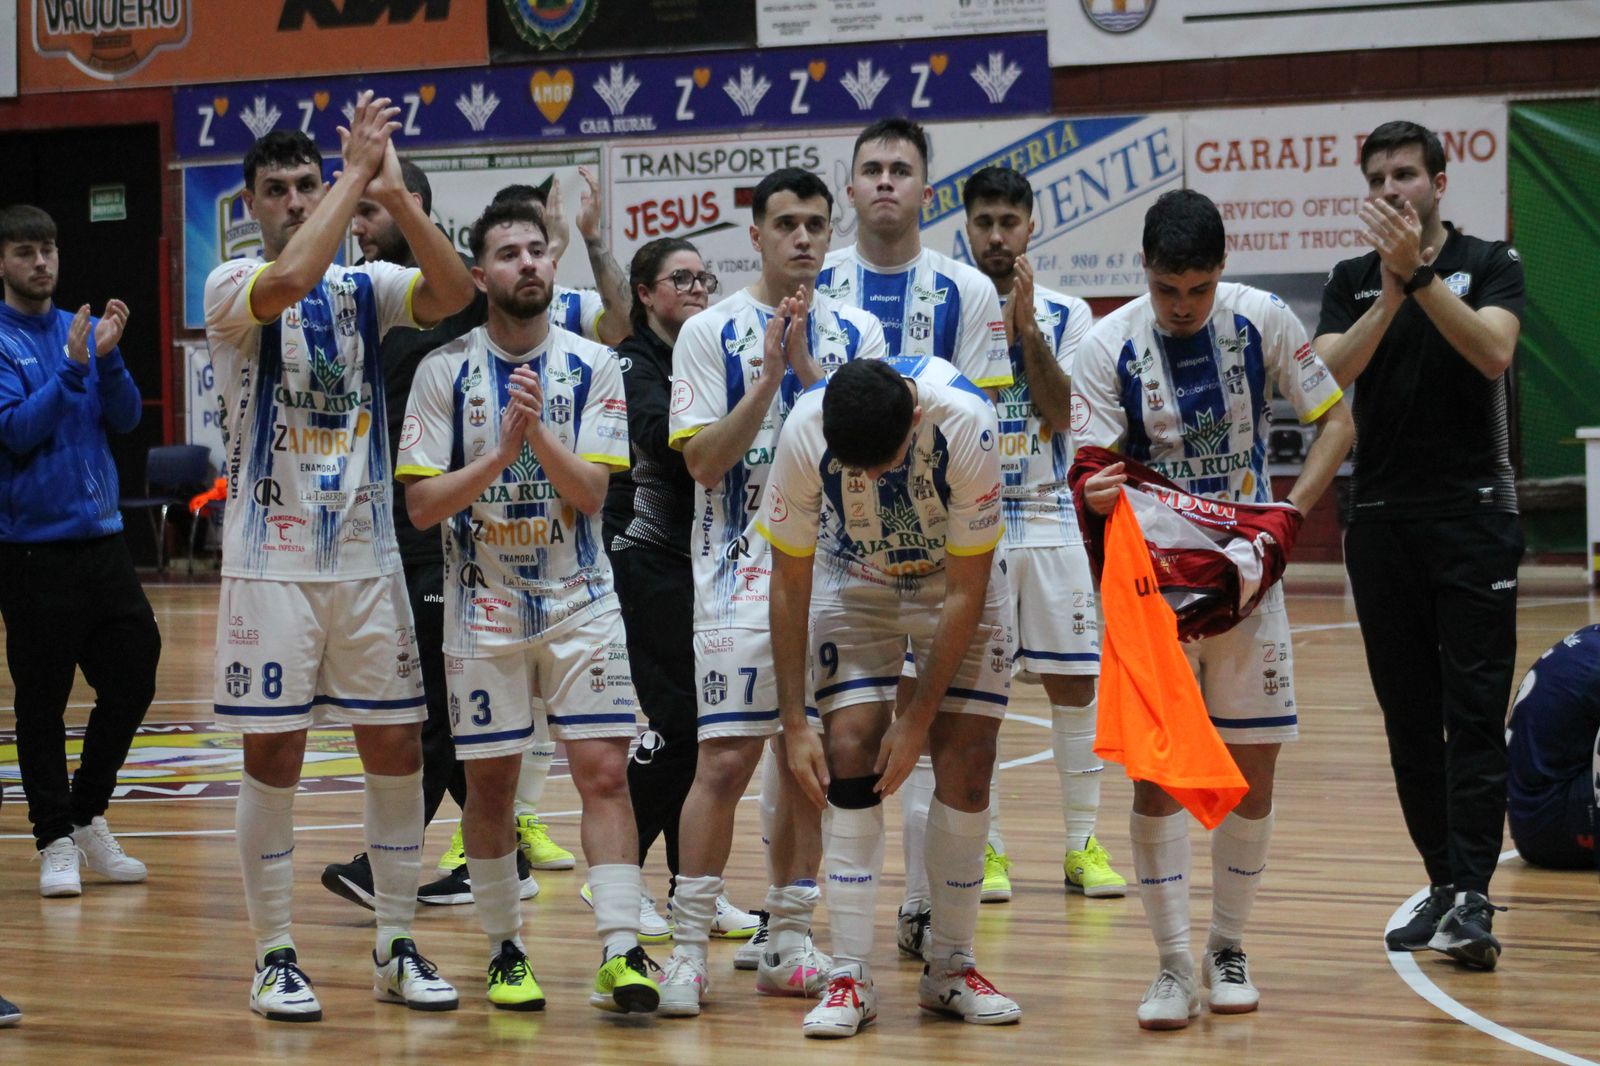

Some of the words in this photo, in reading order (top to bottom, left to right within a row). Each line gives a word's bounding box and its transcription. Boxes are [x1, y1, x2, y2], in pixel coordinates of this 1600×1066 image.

[533, 84, 571, 103] AMOR
[579, 119, 611, 134] CAJA
[612, 115, 657, 133] RURAL
[619, 145, 821, 177] TRANSPORTES
[1195, 134, 1338, 173] GARAJE
[624, 191, 720, 241] JESUS
[1215, 199, 1294, 221] ERVICIO
[1225, 231, 1290, 251] NAULT
[1299, 229, 1372, 249] TRUCK
[718, 258, 763, 273] VIDRIAL
[1034, 254, 1062, 272] Tel.
[1070, 253, 1098, 270] 980
[1106, 253, 1125, 269] 63
[274, 424, 356, 456] ZAMOR
[300, 462, 337, 473] ENAMORA
[476, 485, 511, 503] AJA
[471, 518, 565, 547] ZAMORA
[499, 553, 536, 564] ENAMORA
[854, 540, 894, 558] AJA
[820, 641, 839, 679] 9
[262, 661, 283, 700] 8
[738, 667, 757, 705] 7
[469, 689, 492, 727] 3
